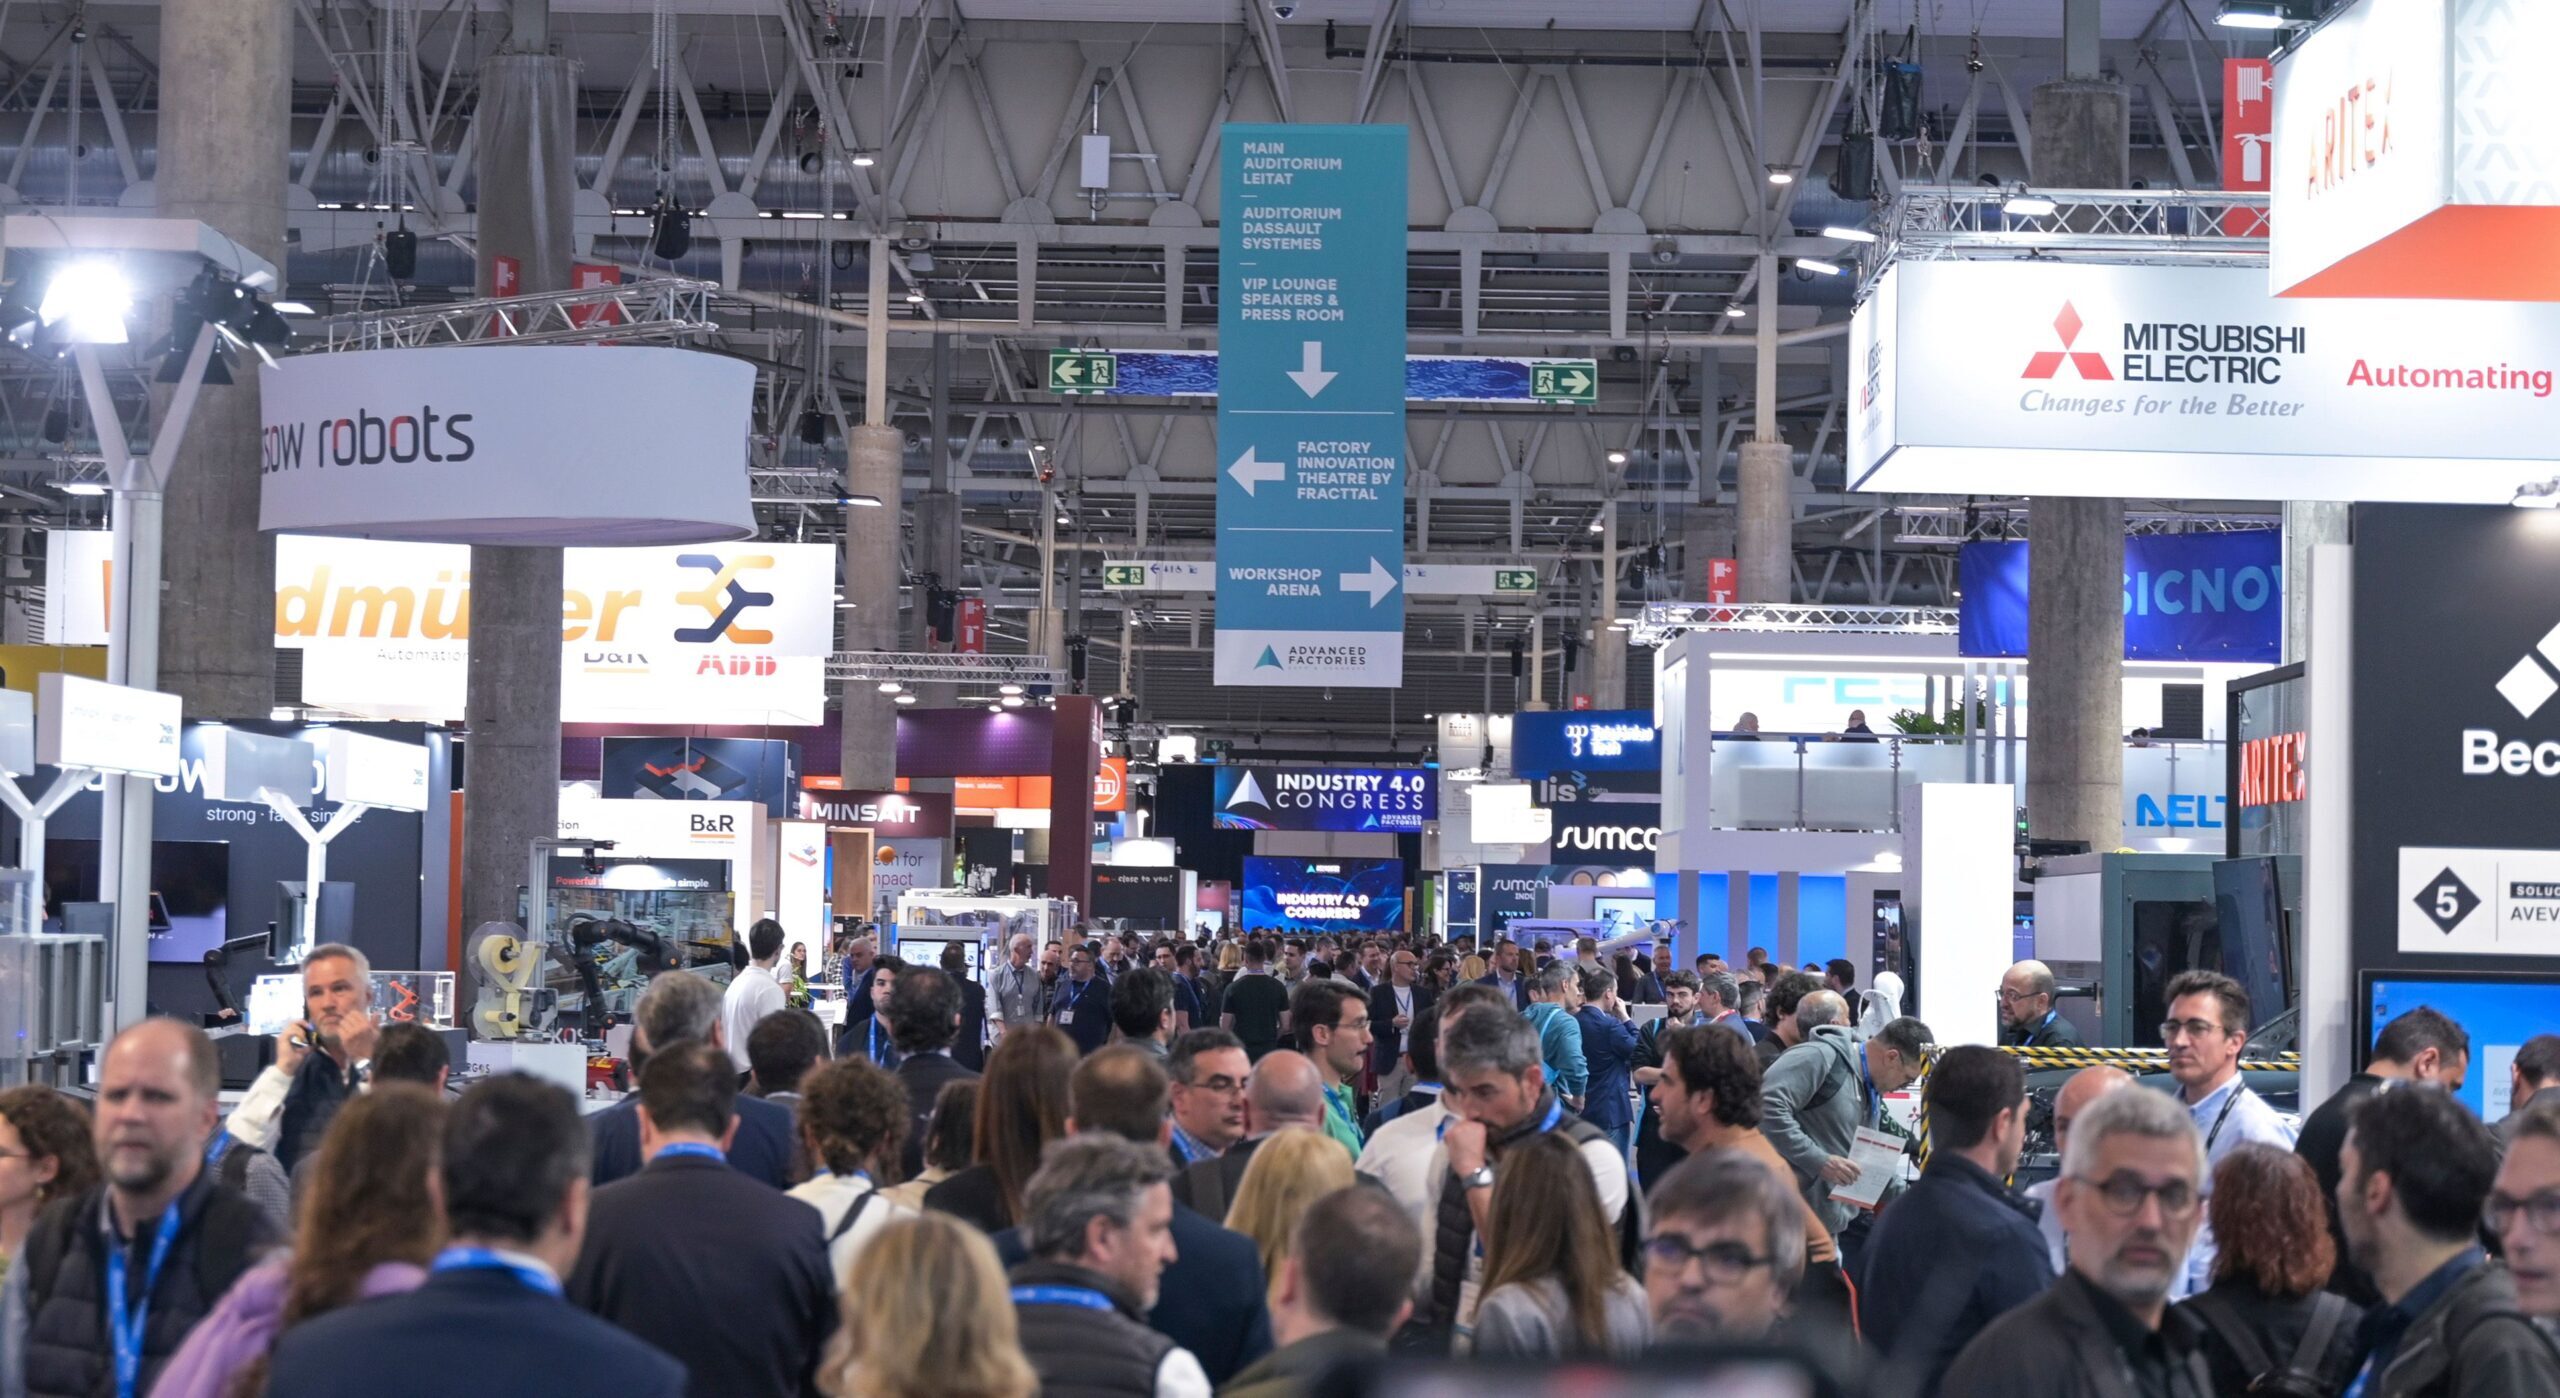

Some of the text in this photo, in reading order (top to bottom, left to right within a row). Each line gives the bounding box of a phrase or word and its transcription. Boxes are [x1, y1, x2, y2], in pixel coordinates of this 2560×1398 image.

[1243, 142, 1284, 154] MAIN
[1243, 157, 1342, 170] AUDITORIUM
[1242, 173, 1294, 185] LEITAT
[1242, 207, 1342, 219] AUDITORIUM
[1242, 223, 1321, 234] DASSAULT
[1242, 238, 1322, 250] SYSTEMES
[1241, 278, 1337, 291] VIP LOUNGE
[1241, 294, 1339, 305] SPEAKERS &
[1241, 309, 1344, 322] PRESS ROOM
[2123, 323, 2305, 355] MITSUBISHI
[2123, 355, 2281, 385] ELECTRIC
[2347, 358, 2553, 397] Automating
[2020, 389, 2304, 418] Changes for the Better
[319, 405, 475, 468] robots
[1297, 442, 1371, 454] FACTORY
[1297, 457, 1395, 469] INNOVATION
[1297, 472, 1392, 485] THEATRE BY
[1297, 488, 1378, 500] FRACTTAL
[1229, 568, 1322, 581] WORKSHOP
[1267, 584, 1321, 597] ARENA
[1289, 646, 1366, 656] ADVANCED
[1289, 656, 1366, 665] FACTORIES
[2462, 729, 2560, 776] Bec
[2240, 732, 2306, 807] ARITEX
[1276, 774, 1425, 792] INDUSTRY 4.0
[1540, 776, 1577, 803] lis
[1276, 792, 1424, 810] CONGRESS
[206, 807, 256, 825] strong
[811, 802, 921, 823] MINSAIT
[2136, 793, 2227, 828] DEL
[691, 814, 734, 832] B&R
[903, 851, 923, 866] for
[2516, 885, 2560, 896] SOLUC
[1277, 893, 1369, 907] INDUSTRY 4.0
[2435, 885, 2458, 919] 5
[1285, 907, 1360, 919] CONGRESS
[2510, 906, 2560, 921] AVEV
